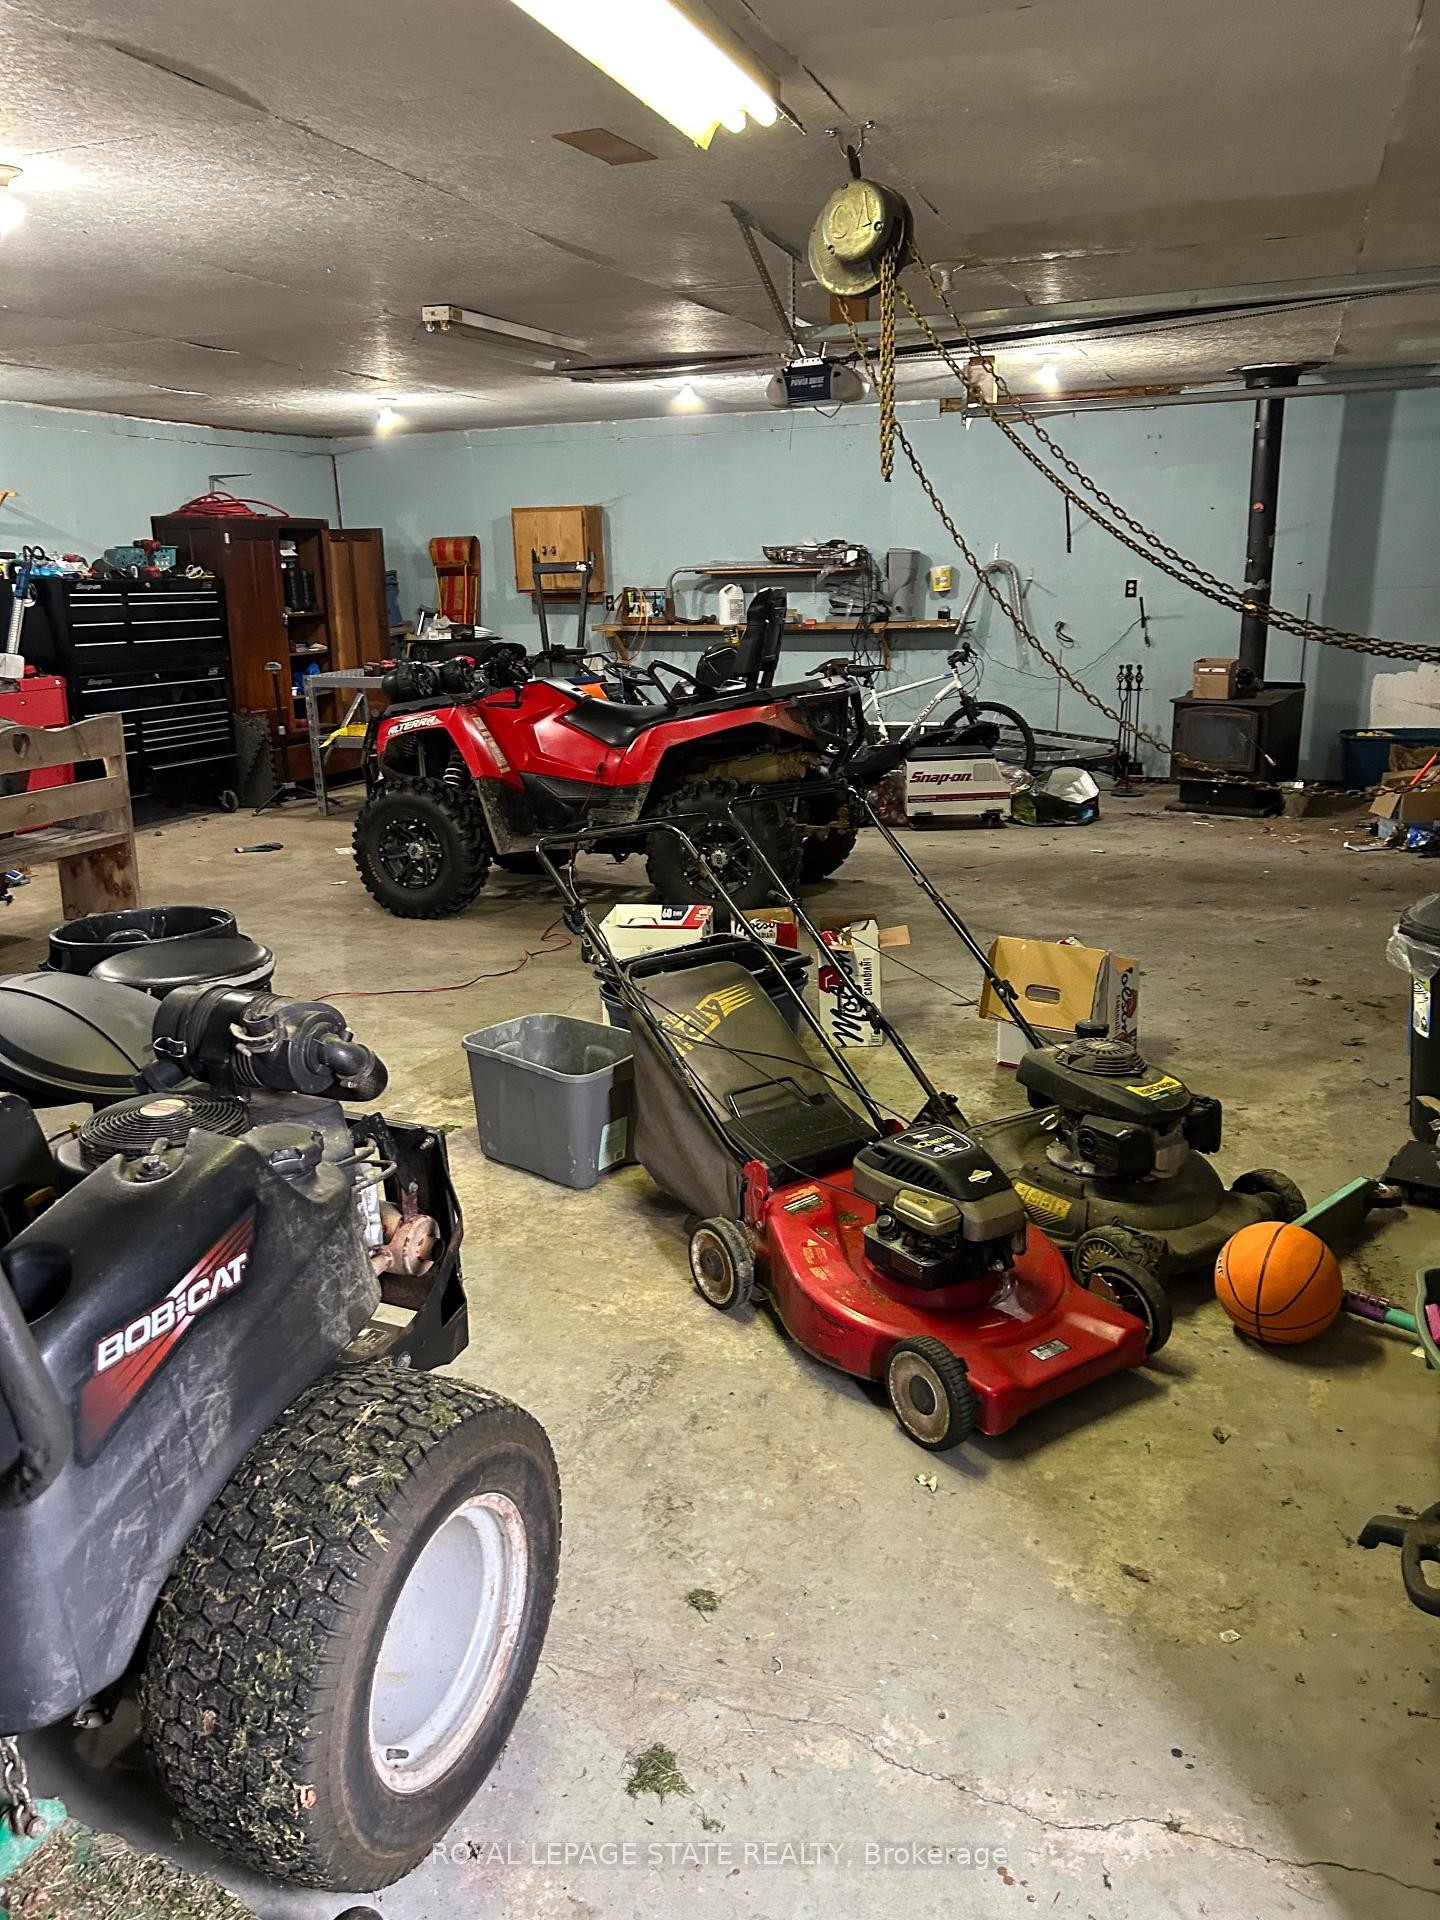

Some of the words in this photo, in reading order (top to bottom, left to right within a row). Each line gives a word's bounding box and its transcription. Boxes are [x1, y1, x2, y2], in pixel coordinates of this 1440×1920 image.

[387, 716, 437, 736] ALTERRA
[909, 771, 972, 785] Snap-on
[662, 908, 673, 919] 60
[863, 961, 873, 996] CANADIAN
